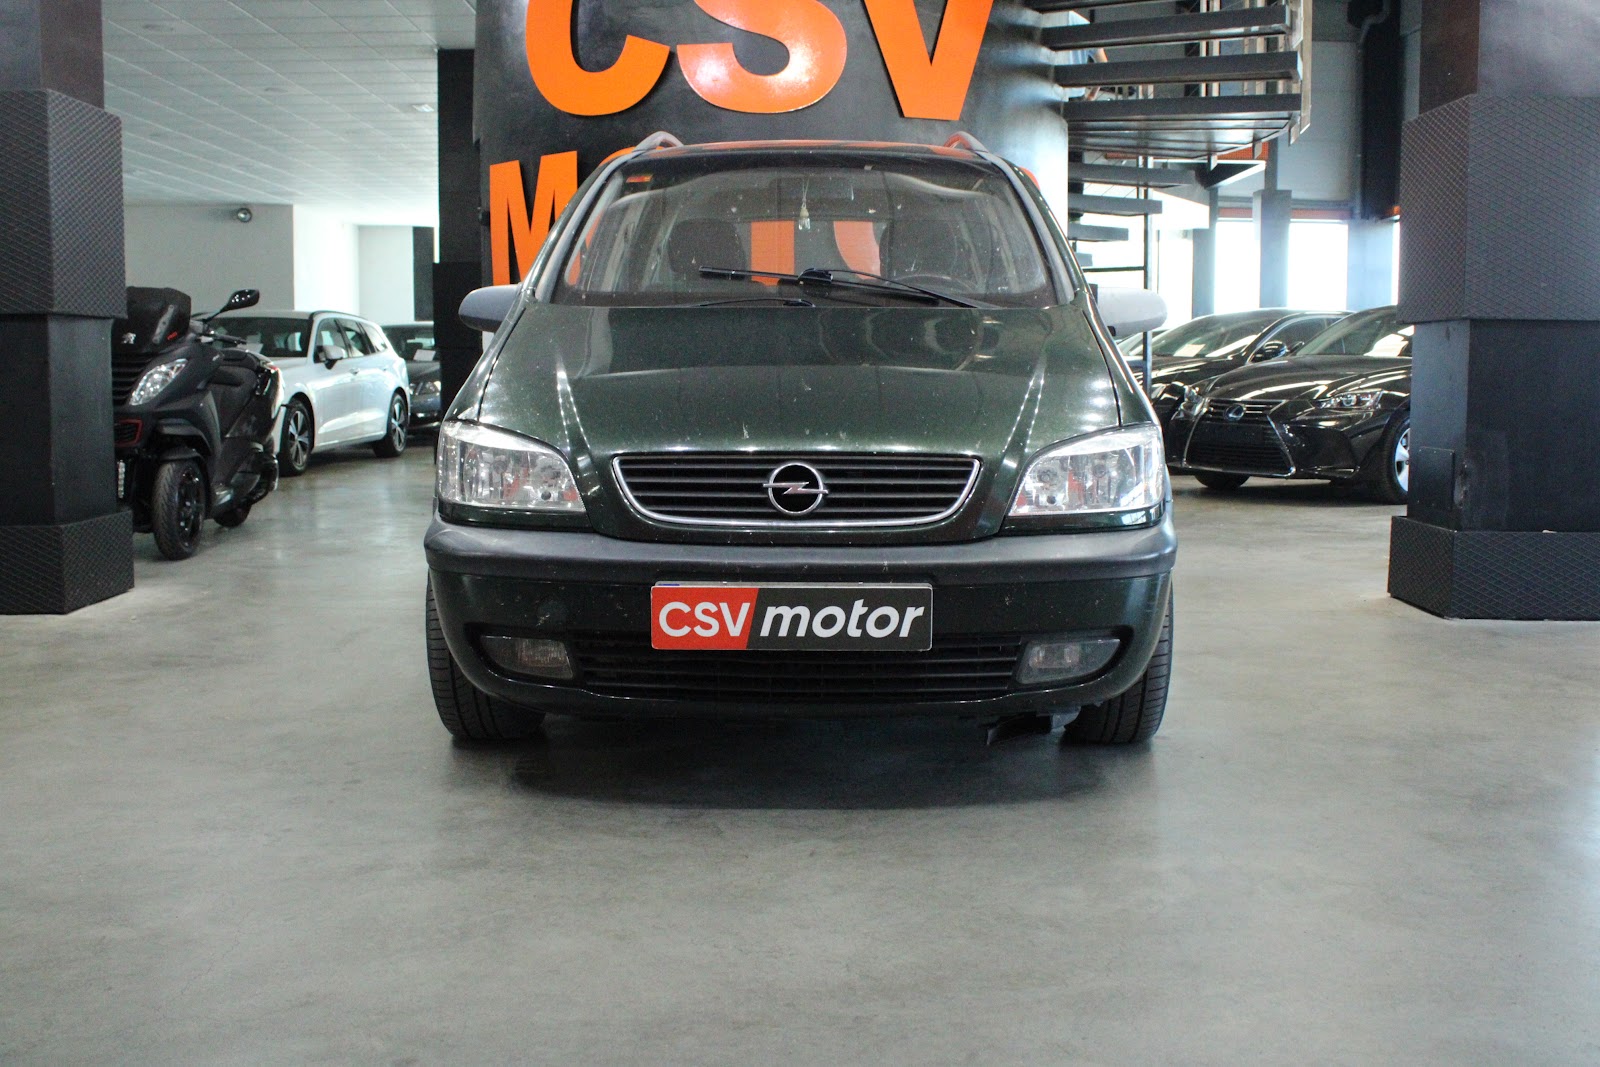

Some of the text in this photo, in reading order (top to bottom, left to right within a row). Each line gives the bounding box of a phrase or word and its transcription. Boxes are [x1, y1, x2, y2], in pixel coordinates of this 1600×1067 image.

[525, 0, 993, 120] CSV
[658, 598, 925, 638] CSV motor
